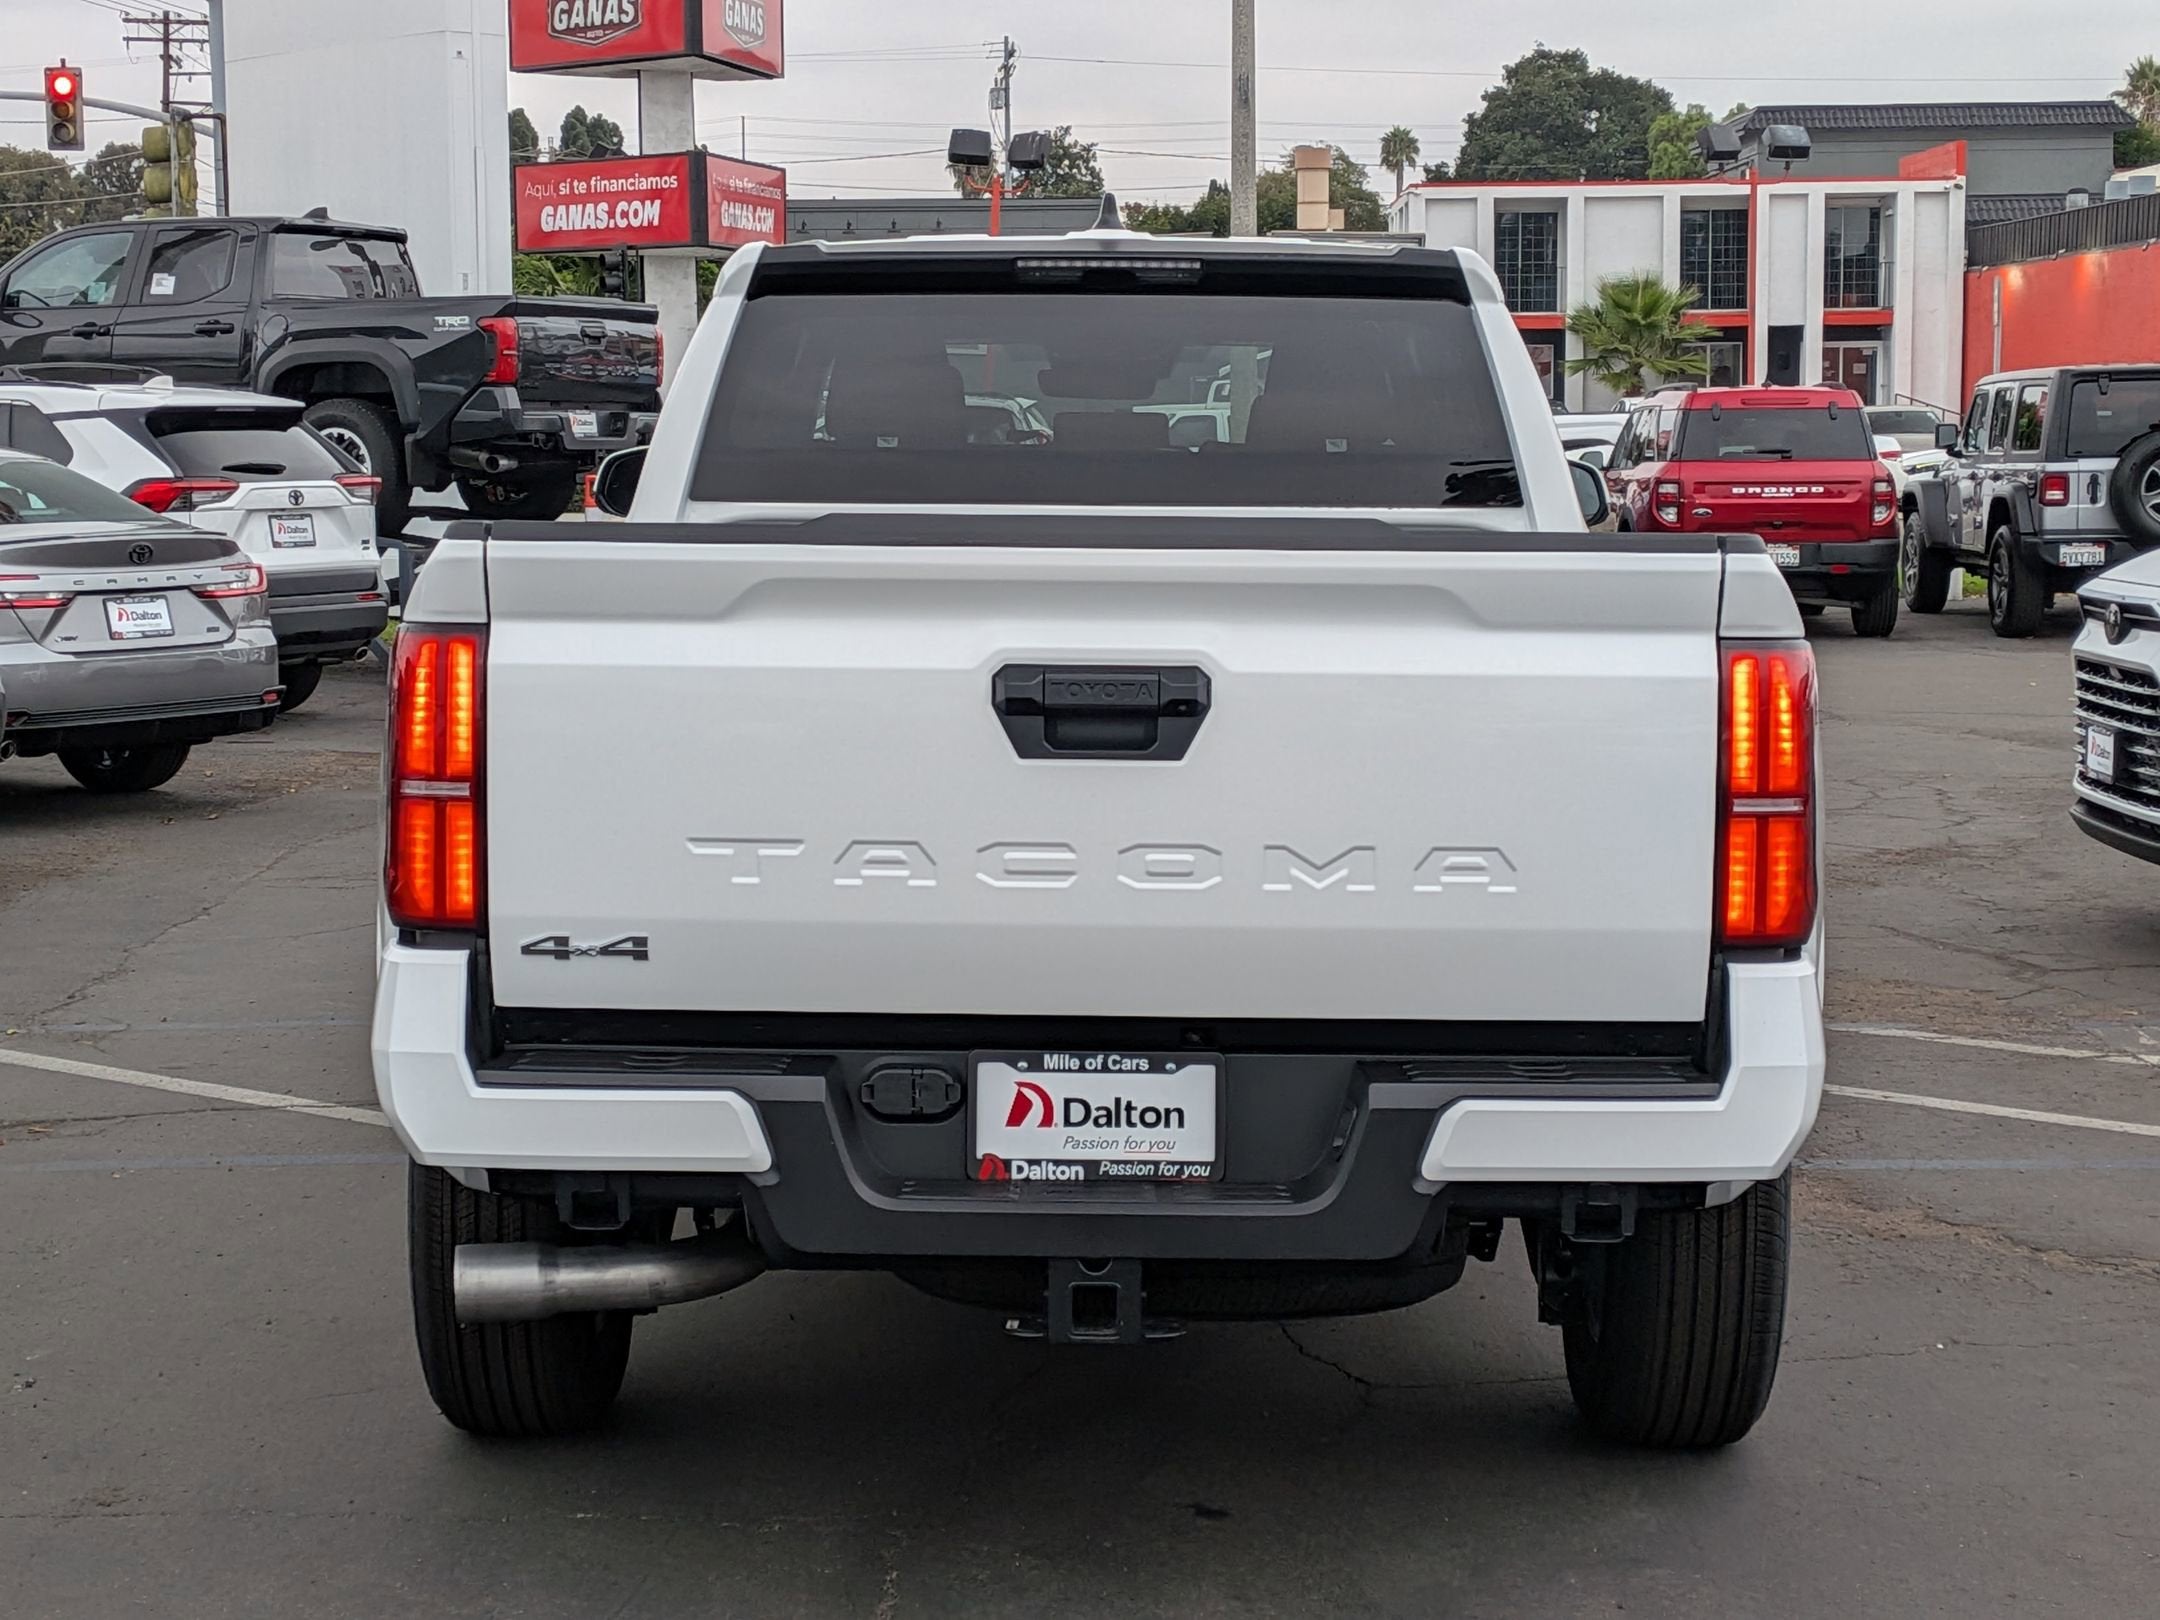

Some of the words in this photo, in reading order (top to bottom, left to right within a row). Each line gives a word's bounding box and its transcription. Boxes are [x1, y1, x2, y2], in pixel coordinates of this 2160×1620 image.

[553, 0, 635, 31] GANAS
[724, 0, 764, 37] GANAS
[559, 179, 571, 195] sí
[573, 179, 587, 194] te
[590, 173, 678, 193] financiamos
[540, 199, 662, 232] GANAS.COM
[73, 574, 203, 586] CAMRY
[130, 610, 162, 621] Dalton
[1050, 681, 1153, 699] TOYOTA
[686, 837, 1517, 893] TACOMA
[1043, 1053, 1079, 1070] Mile
[1085, 1054, 1104, 1071] of
[1107, 1055, 1149, 1071] Cars
[1062, 1096, 1185, 1129] Dalton
[1062, 1135, 1119, 1150] Passion
[1123, 1136, 1146, 1151] for
[1148, 1140, 1176, 1153] you
[1011, 1161, 1085, 1181] Dalton
[1099, 1161, 1154, 1177] Passion
[1157, 1162, 1181, 1178] for
[1181, 1164, 1211, 1181] you
